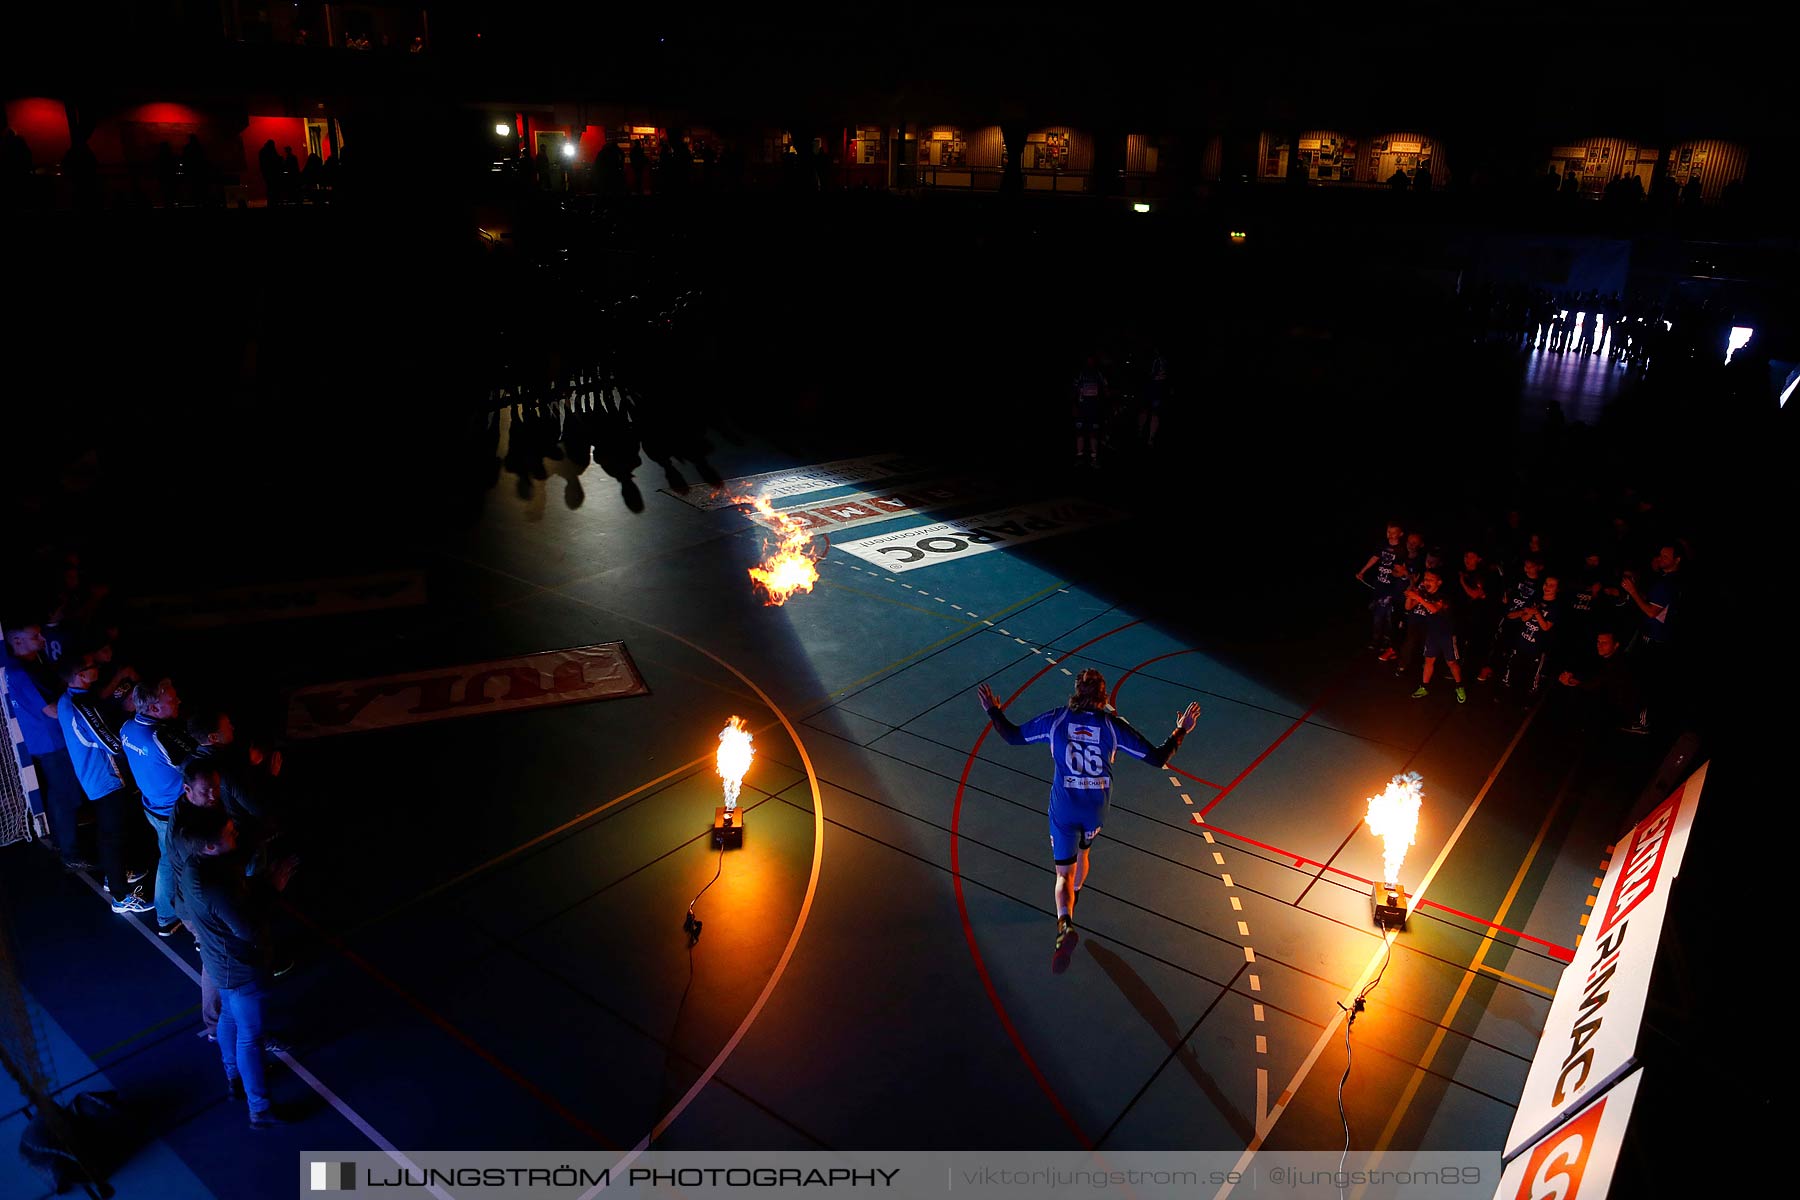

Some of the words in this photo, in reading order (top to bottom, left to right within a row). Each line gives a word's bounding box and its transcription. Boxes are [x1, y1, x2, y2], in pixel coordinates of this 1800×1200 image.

[876, 517, 1057, 563] PAROC
[1065, 742, 1103, 776] 66
[1610, 806, 1674, 923] EXTRA
